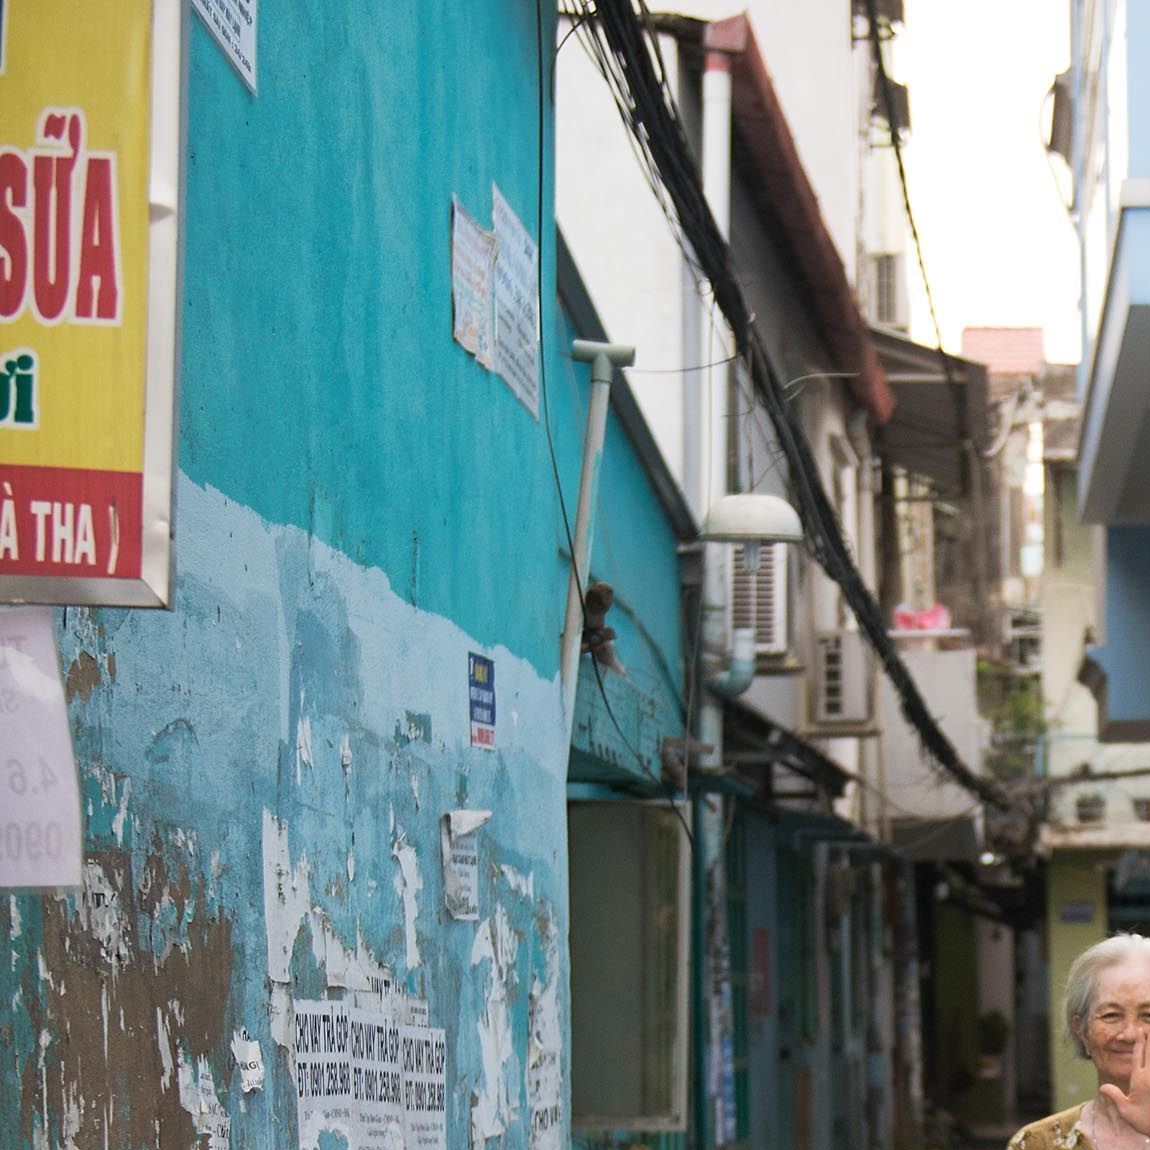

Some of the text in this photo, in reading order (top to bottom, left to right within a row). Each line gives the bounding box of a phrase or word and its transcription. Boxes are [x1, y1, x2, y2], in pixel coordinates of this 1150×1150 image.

[0, 113, 118, 320] SỮA
[30, 500, 97, 565] THA
[295, 1013, 309, 1054] CHO
[309, 1013, 322, 1054] VAY
[351, 1020, 364, 1060] CHO
[364, 1022, 376, 1062] VAY
[402, 1036, 415, 1073] CHO
[414, 1038, 425, 1074] VAY
